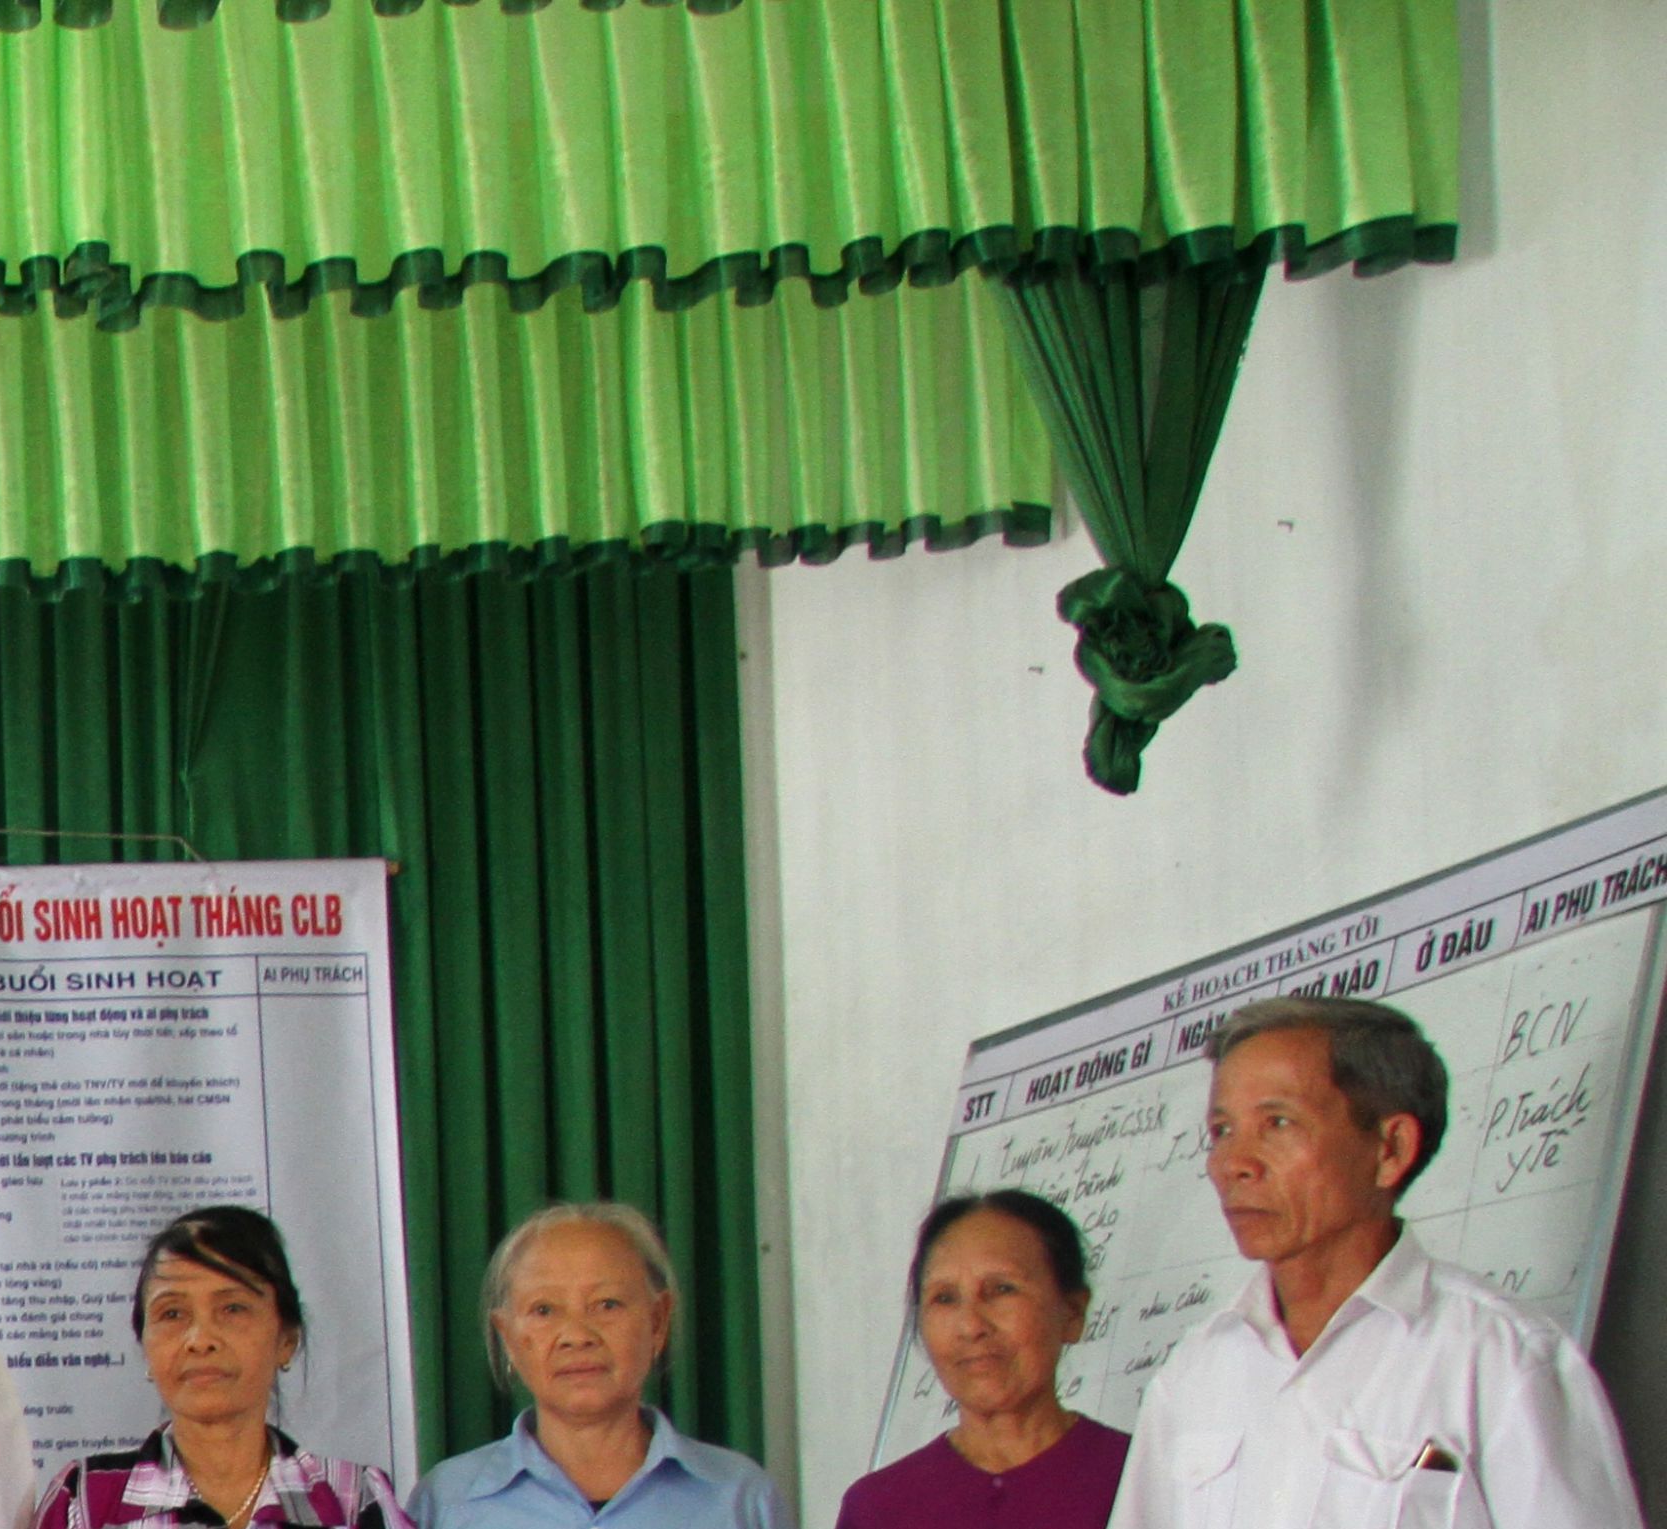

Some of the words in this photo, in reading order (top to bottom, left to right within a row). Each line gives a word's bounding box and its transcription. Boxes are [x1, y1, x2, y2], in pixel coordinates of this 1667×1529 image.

[33, 898, 103, 941] SINH
[111, 895, 182, 948] HOẠT
[190, 886, 283, 938] THÁNG
[291, 893, 343, 937] CLB
[66, 971, 135, 991] SINH
[147, 970, 222, 992] HOẠT
[263, 968, 277, 983] AI
[281, 967, 310, 985] PHỤ
[316, 963, 364, 983] TRÁCH
[962, 1091, 997, 1123] STT
[1026, 1066, 1074, 1105] HOẠT
[1074, 1048, 1127, 1090] ĐỘNG
[1130, 1032, 1153, 1069] GÌ
[1415, 929, 1437, 974] Ở
[1438, 918, 1495, 966] ĐÂU
[1523, 898, 1549, 937] AI
[1551, 879, 1599, 926] PHỤ
[1600, 853, 1667, 908] TRÁCH
[1163, 977, 1187, 1012] KẾ
[1191, 961, 1259, 1000] HOẠCH
[1266, 938, 1336, 975] THÁNG
[1342, 914, 1380, 948] TỚI
[1502, 997, 1588, 1064] BCN
